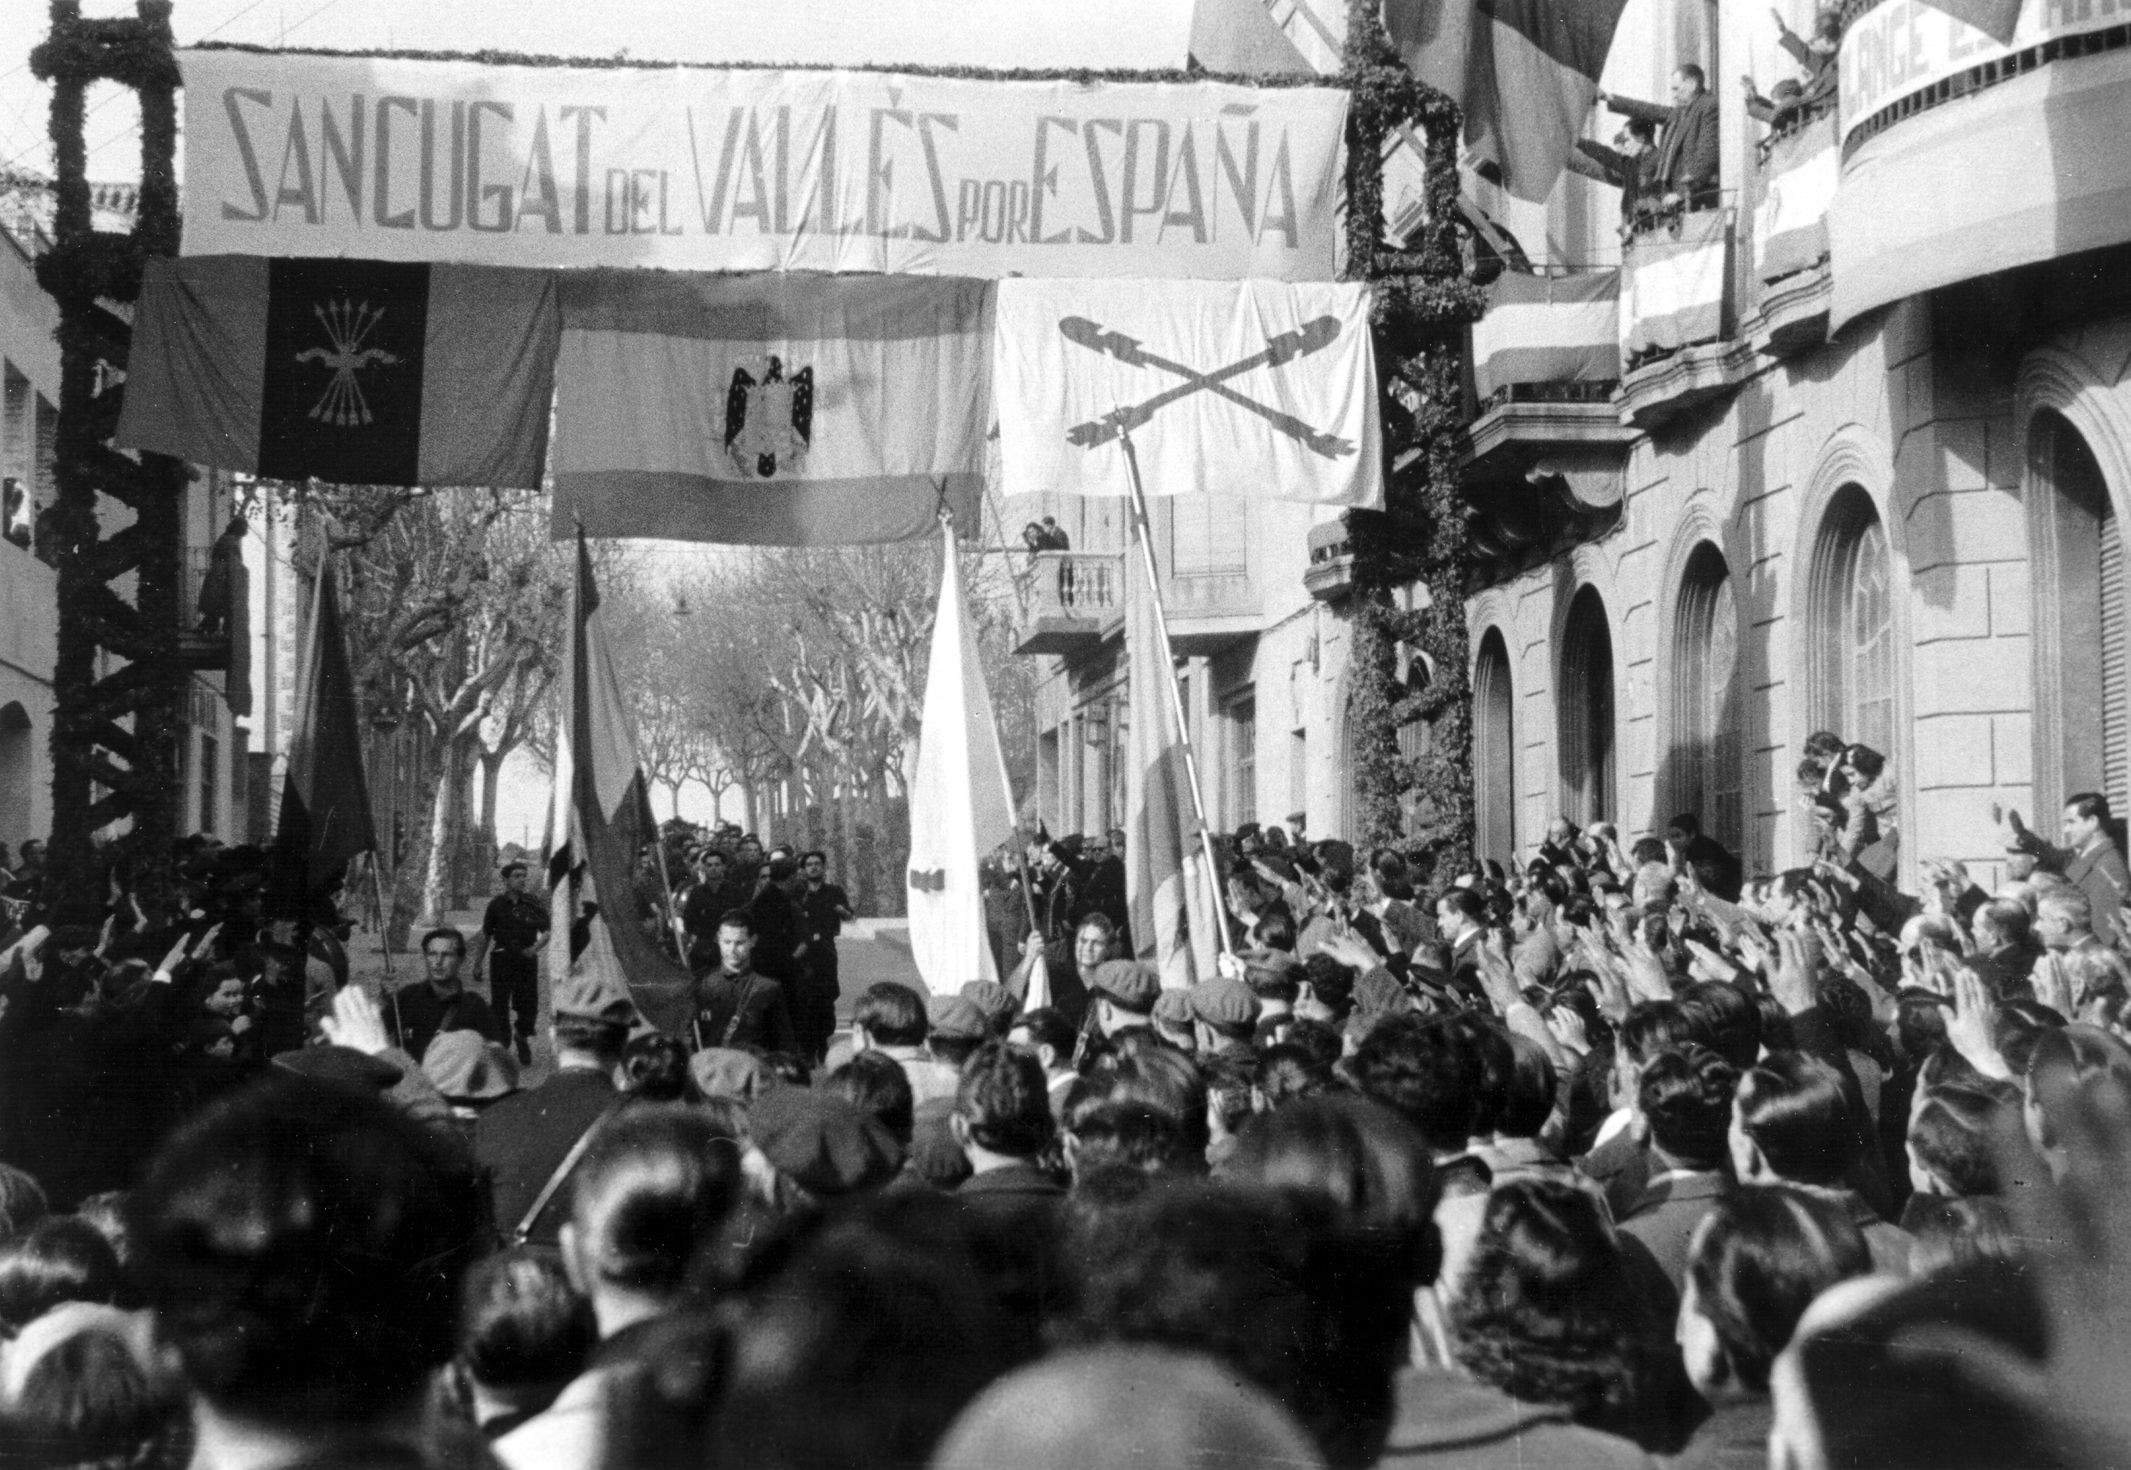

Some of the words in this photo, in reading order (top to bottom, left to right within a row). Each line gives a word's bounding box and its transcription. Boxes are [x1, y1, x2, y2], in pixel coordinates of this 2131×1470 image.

[604, 168, 683, 236] DEL
[956, 178, 1029, 244] POR
[1027, 103, 1299, 249] ESPAÑA
